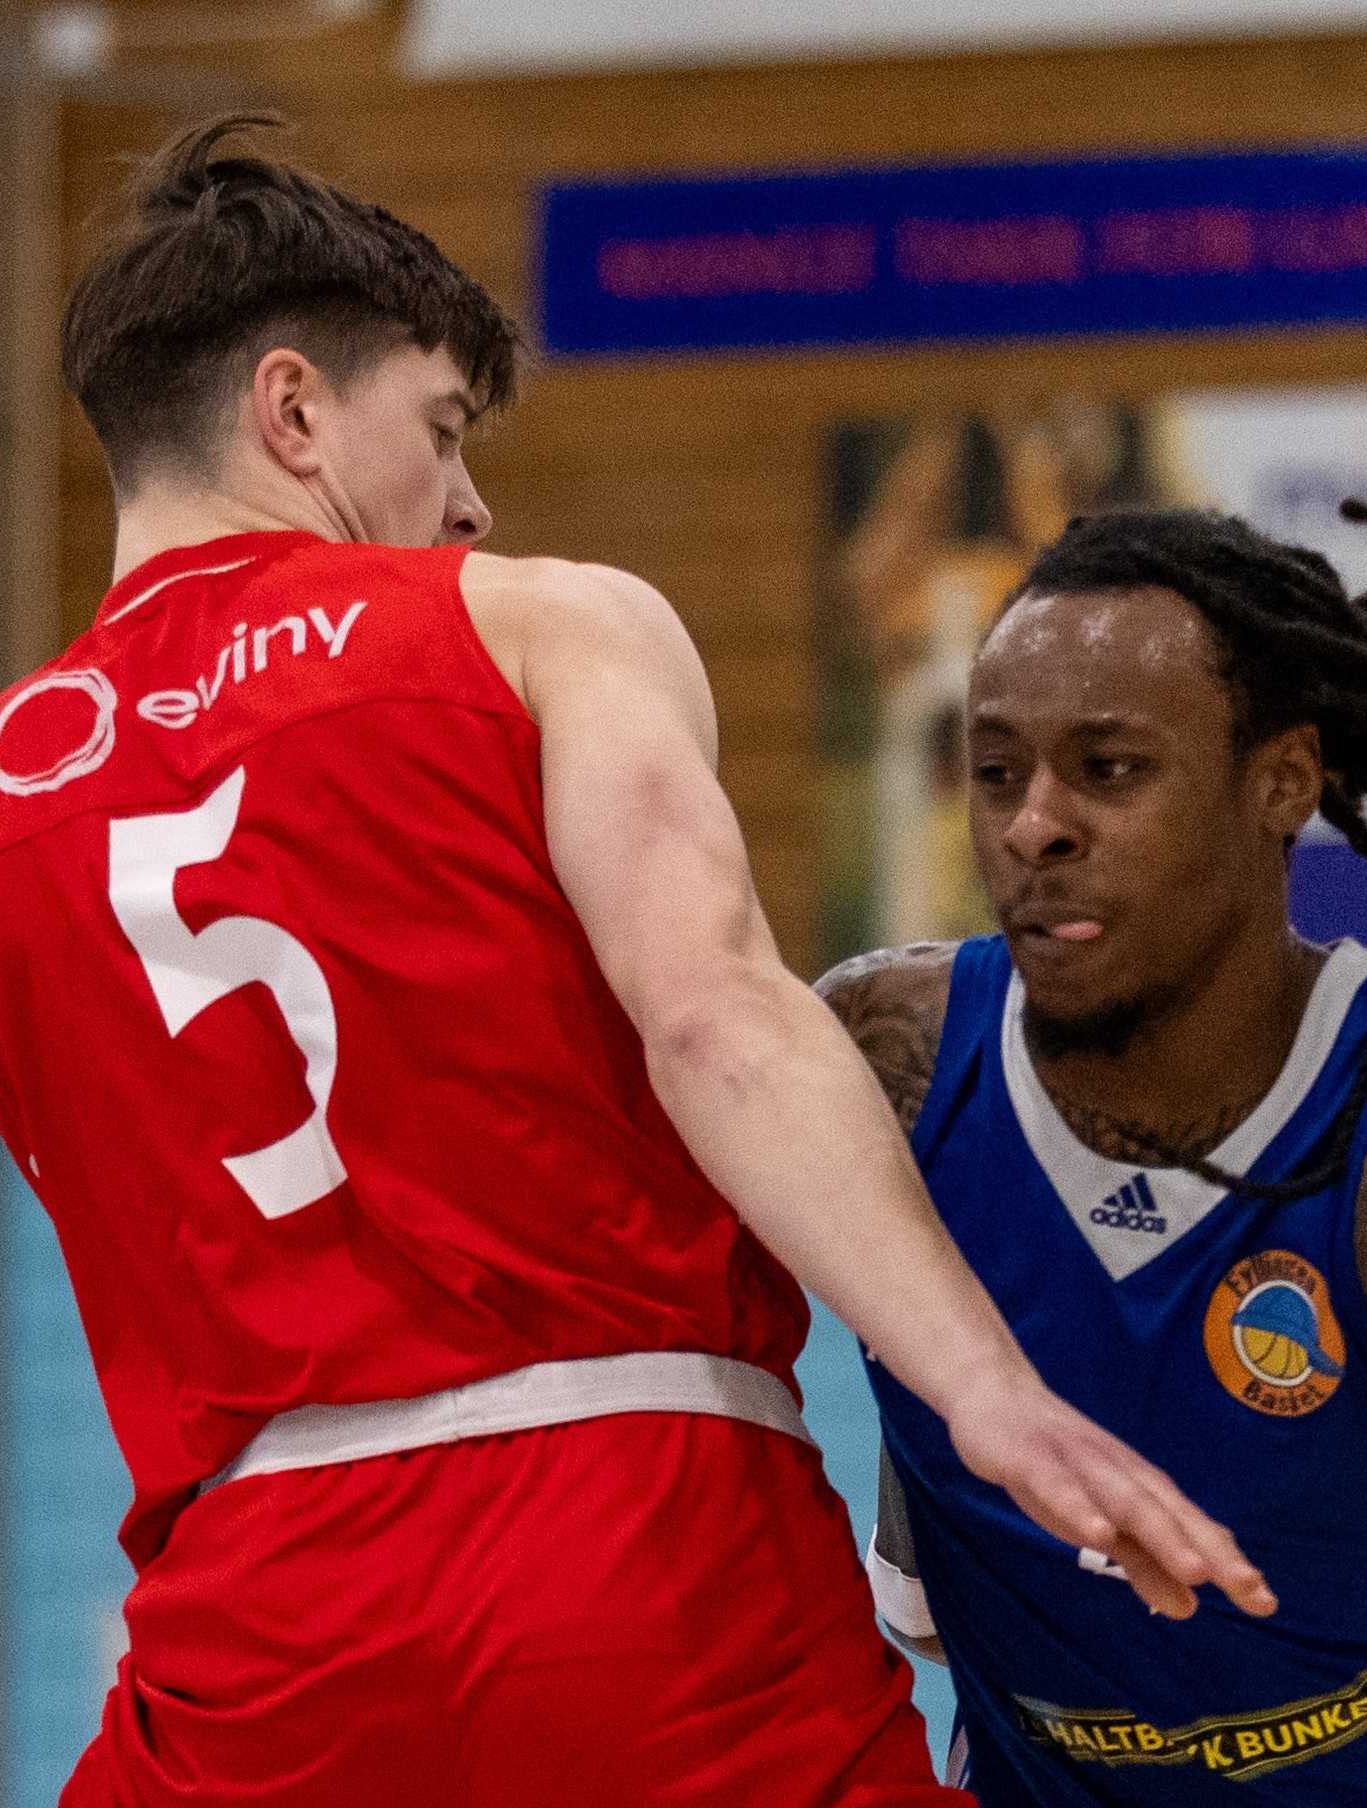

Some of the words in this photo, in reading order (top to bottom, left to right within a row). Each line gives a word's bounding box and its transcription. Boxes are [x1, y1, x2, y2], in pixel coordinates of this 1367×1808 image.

[136, 600, 368, 729] eviny
[107, 765, 349, 1220] 5
[1089, 1205, 1167, 1234] adidas
[1243, 1379, 1325, 1413] Basket
